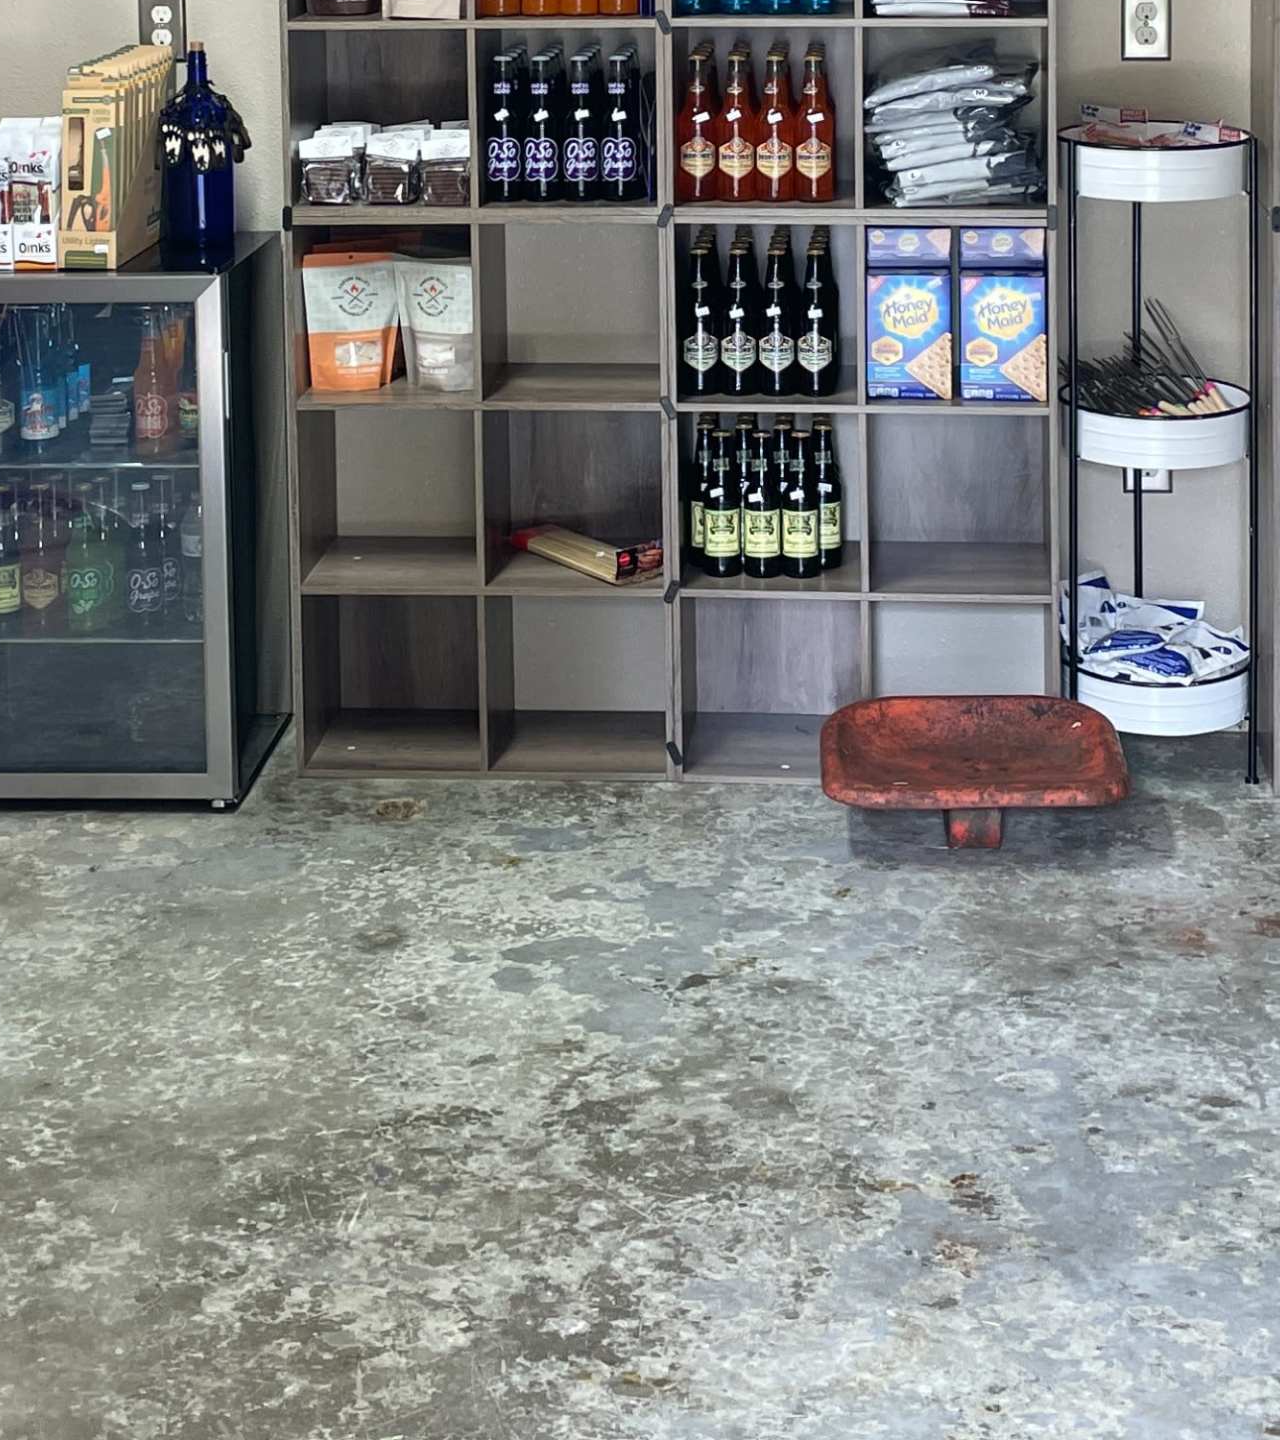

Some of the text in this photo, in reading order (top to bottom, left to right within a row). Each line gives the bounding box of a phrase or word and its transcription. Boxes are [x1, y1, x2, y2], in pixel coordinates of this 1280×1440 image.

[488, 142, 516, 158] O-So
[525, 142, 553, 158] O-So
[567, 142, 595, 158] O-So
[604, 142, 632, 158] O-So
[883, 296, 933, 319] Honey
[977, 297, 1028, 320] Honey
[892, 313, 929, 329] Maid
[986, 315, 1024, 330] Maid
[71, 574, 97, 588] O-So
[130, 574, 159, 589] O-So
